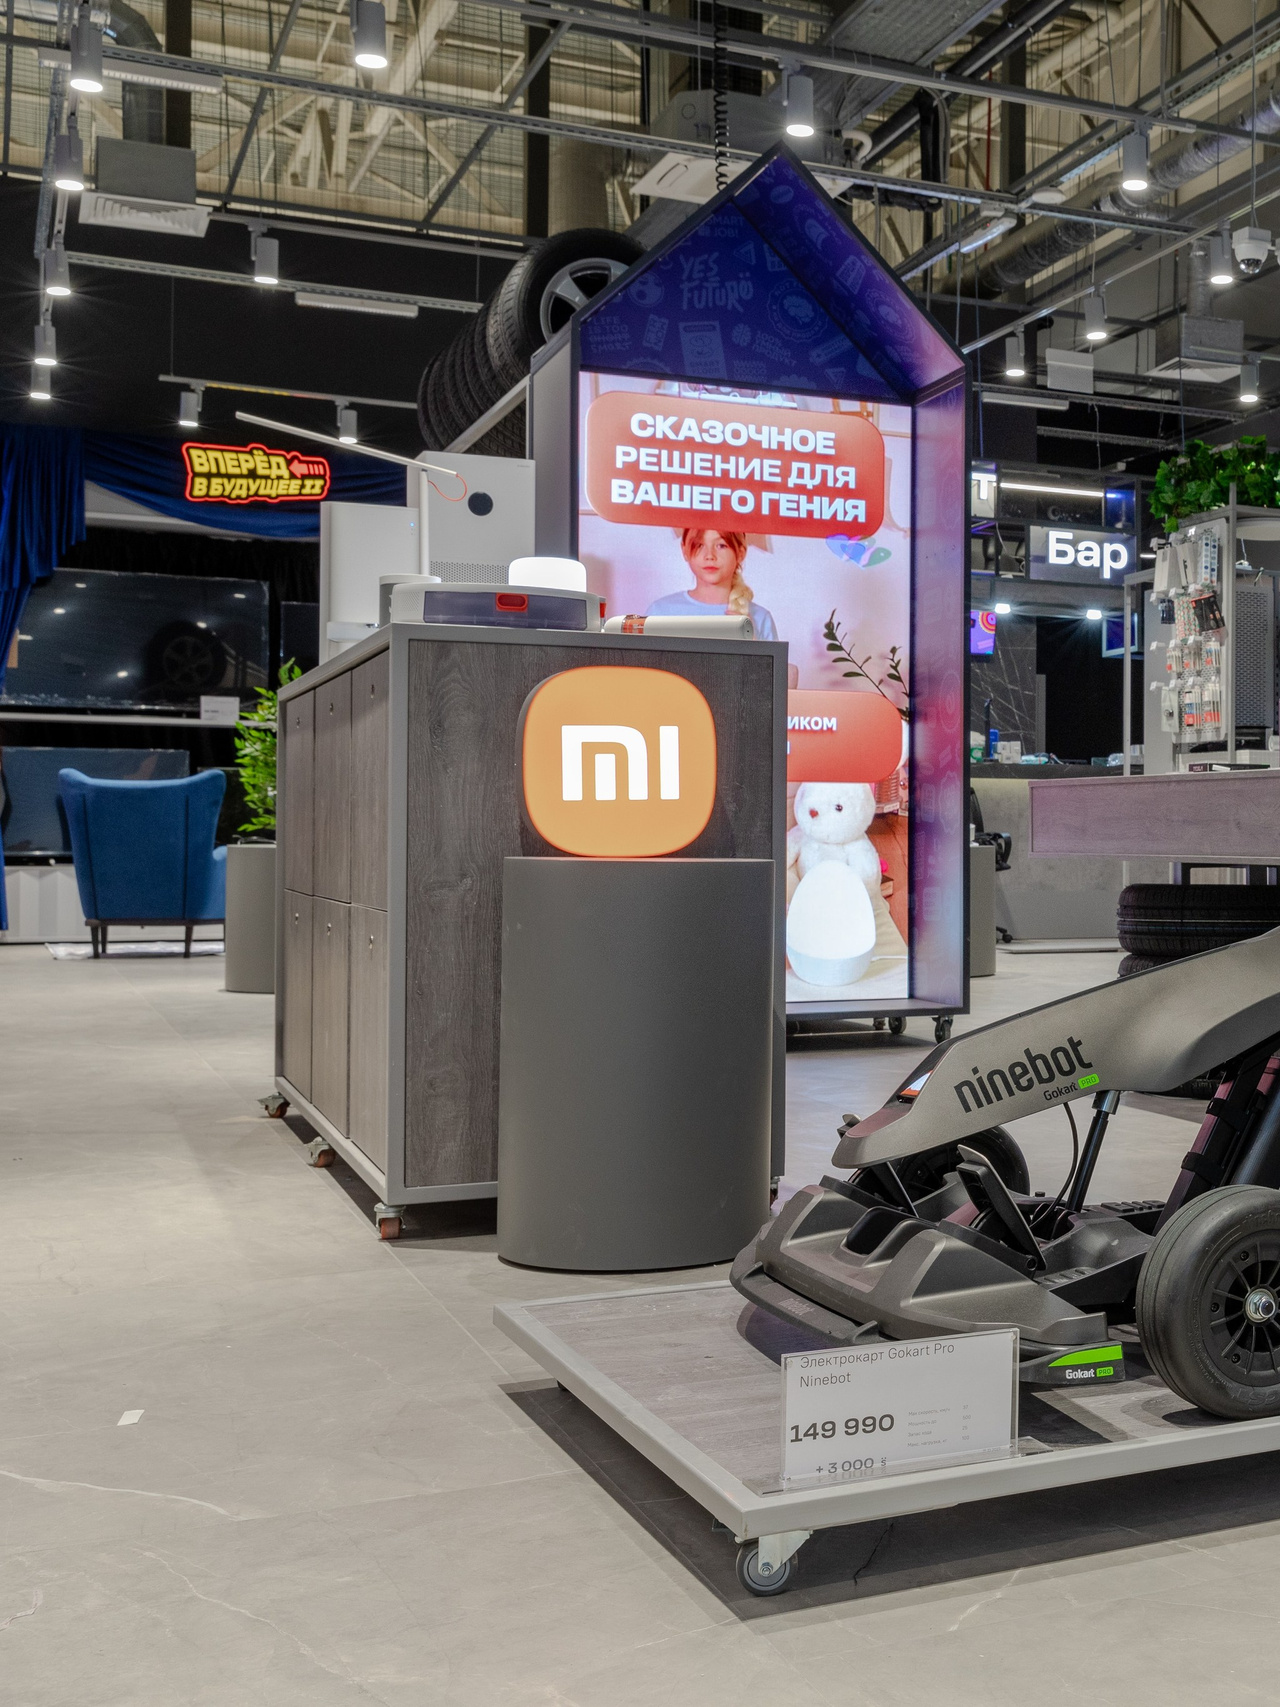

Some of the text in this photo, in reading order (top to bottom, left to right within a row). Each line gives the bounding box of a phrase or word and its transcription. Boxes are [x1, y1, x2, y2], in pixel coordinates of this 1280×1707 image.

[679, 251, 720, 281] YES
[630, 413, 836, 455] СКАЗОЧНОЕ
[189, 449, 290, 479] ВПЕРЁД
[615, 445, 856, 490] РЕШЕНИЕ ДЛЯ
[192, 477, 208, 497] В
[208, 477, 303, 499] БУДУЩЕЕ
[611, 479, 867, 523] ВАШЕГО ГЕНИЯ
[1049, 530, 1129, 579] Бар
[954, 1036, 1093, 1114] ninebot
[1043, 1077, 1098, 1101] Gokart PRO
[799, 1342, 955, 1369] Электрокарт Gokart Pro
[799, 1372, 851, 1388] Ninebot
[1065, 1368, 1112, 1379] Gokart PRO
[790, 1414, 895, 1443] 149 990
[828, 1462, 838, 1474] 3
[841, 1457, 874, 1472] 000
